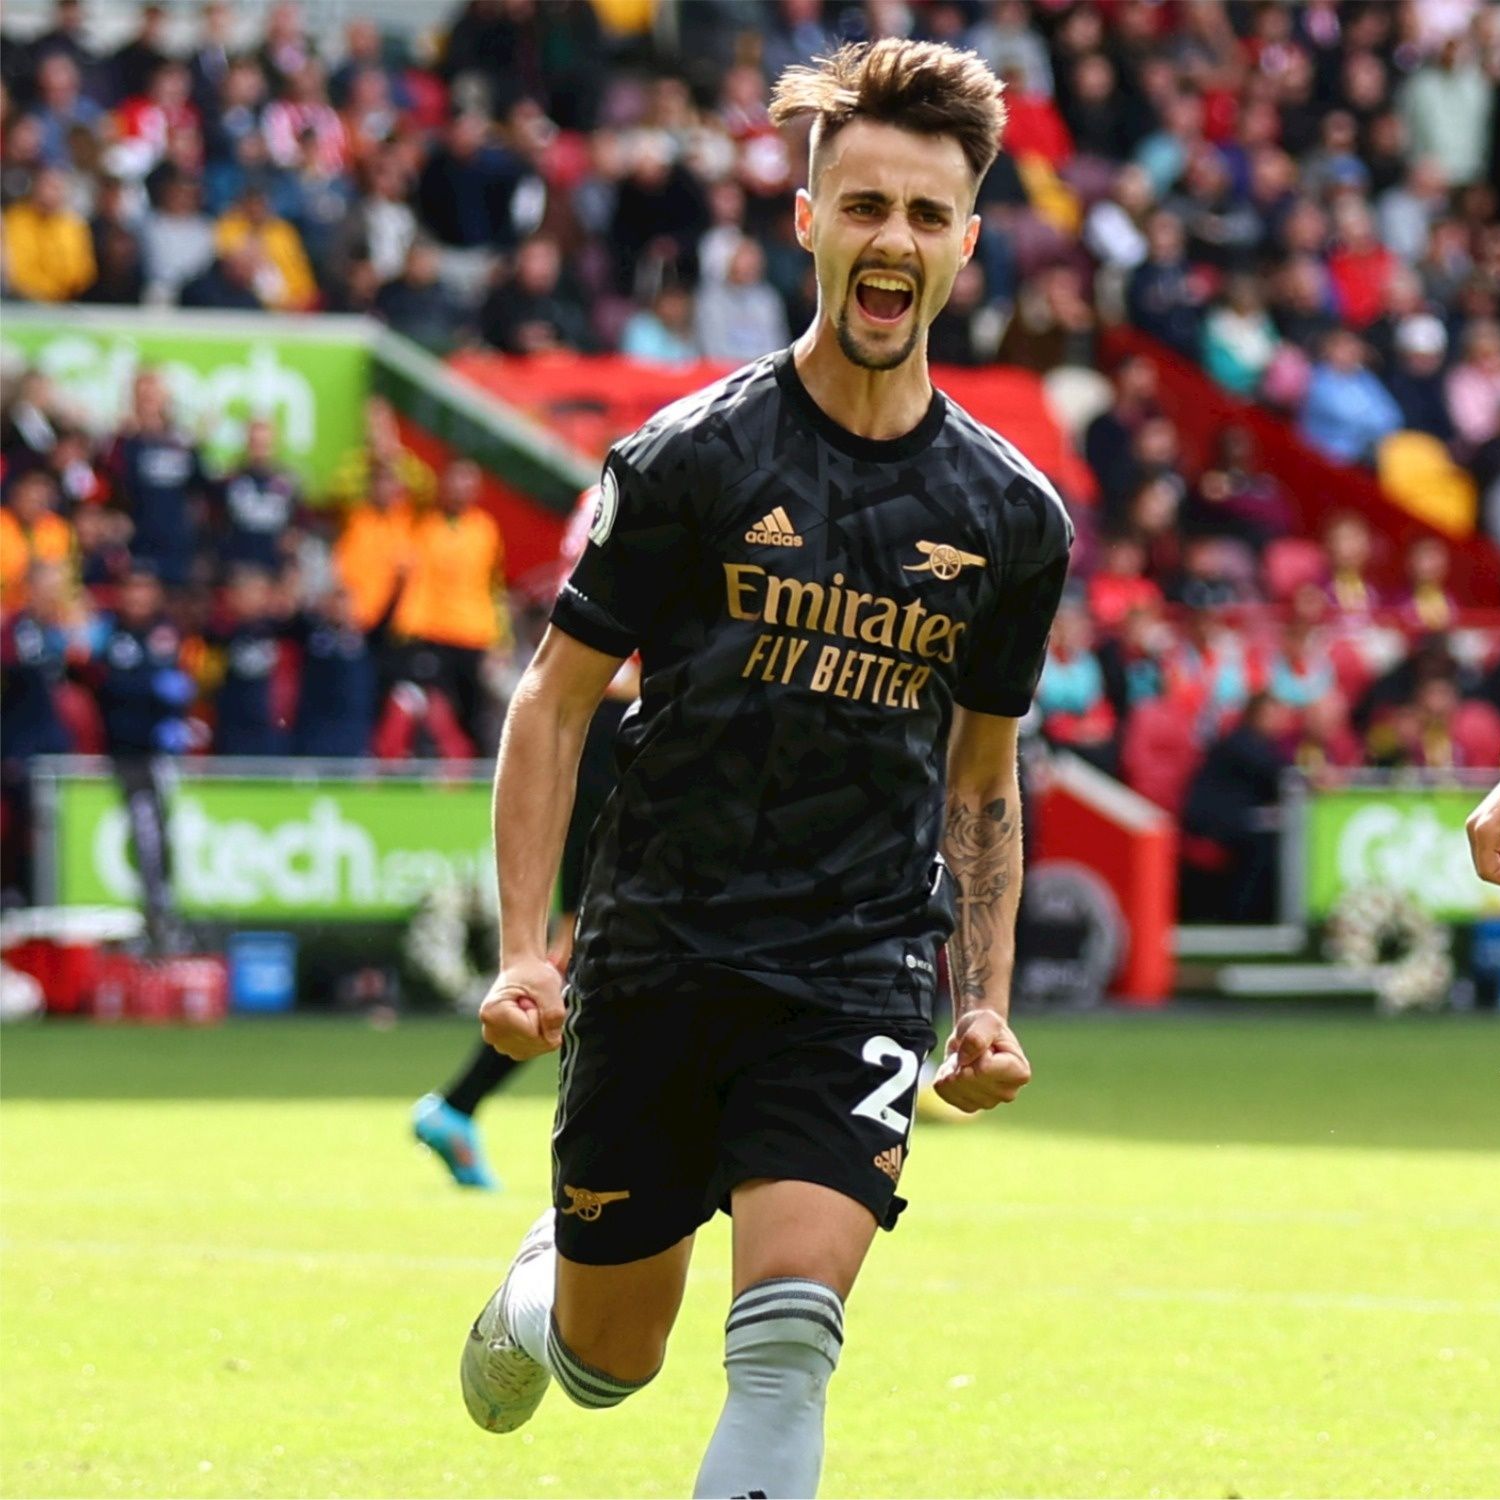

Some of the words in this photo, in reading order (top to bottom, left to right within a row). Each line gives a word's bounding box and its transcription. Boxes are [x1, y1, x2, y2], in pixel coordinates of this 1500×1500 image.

[744, 531, 804, 547] adidas
[722, 562, 967, 663] Emirates
[741, 634, 809, 685] FLY
[810, 645, 930, 710] BETTER
